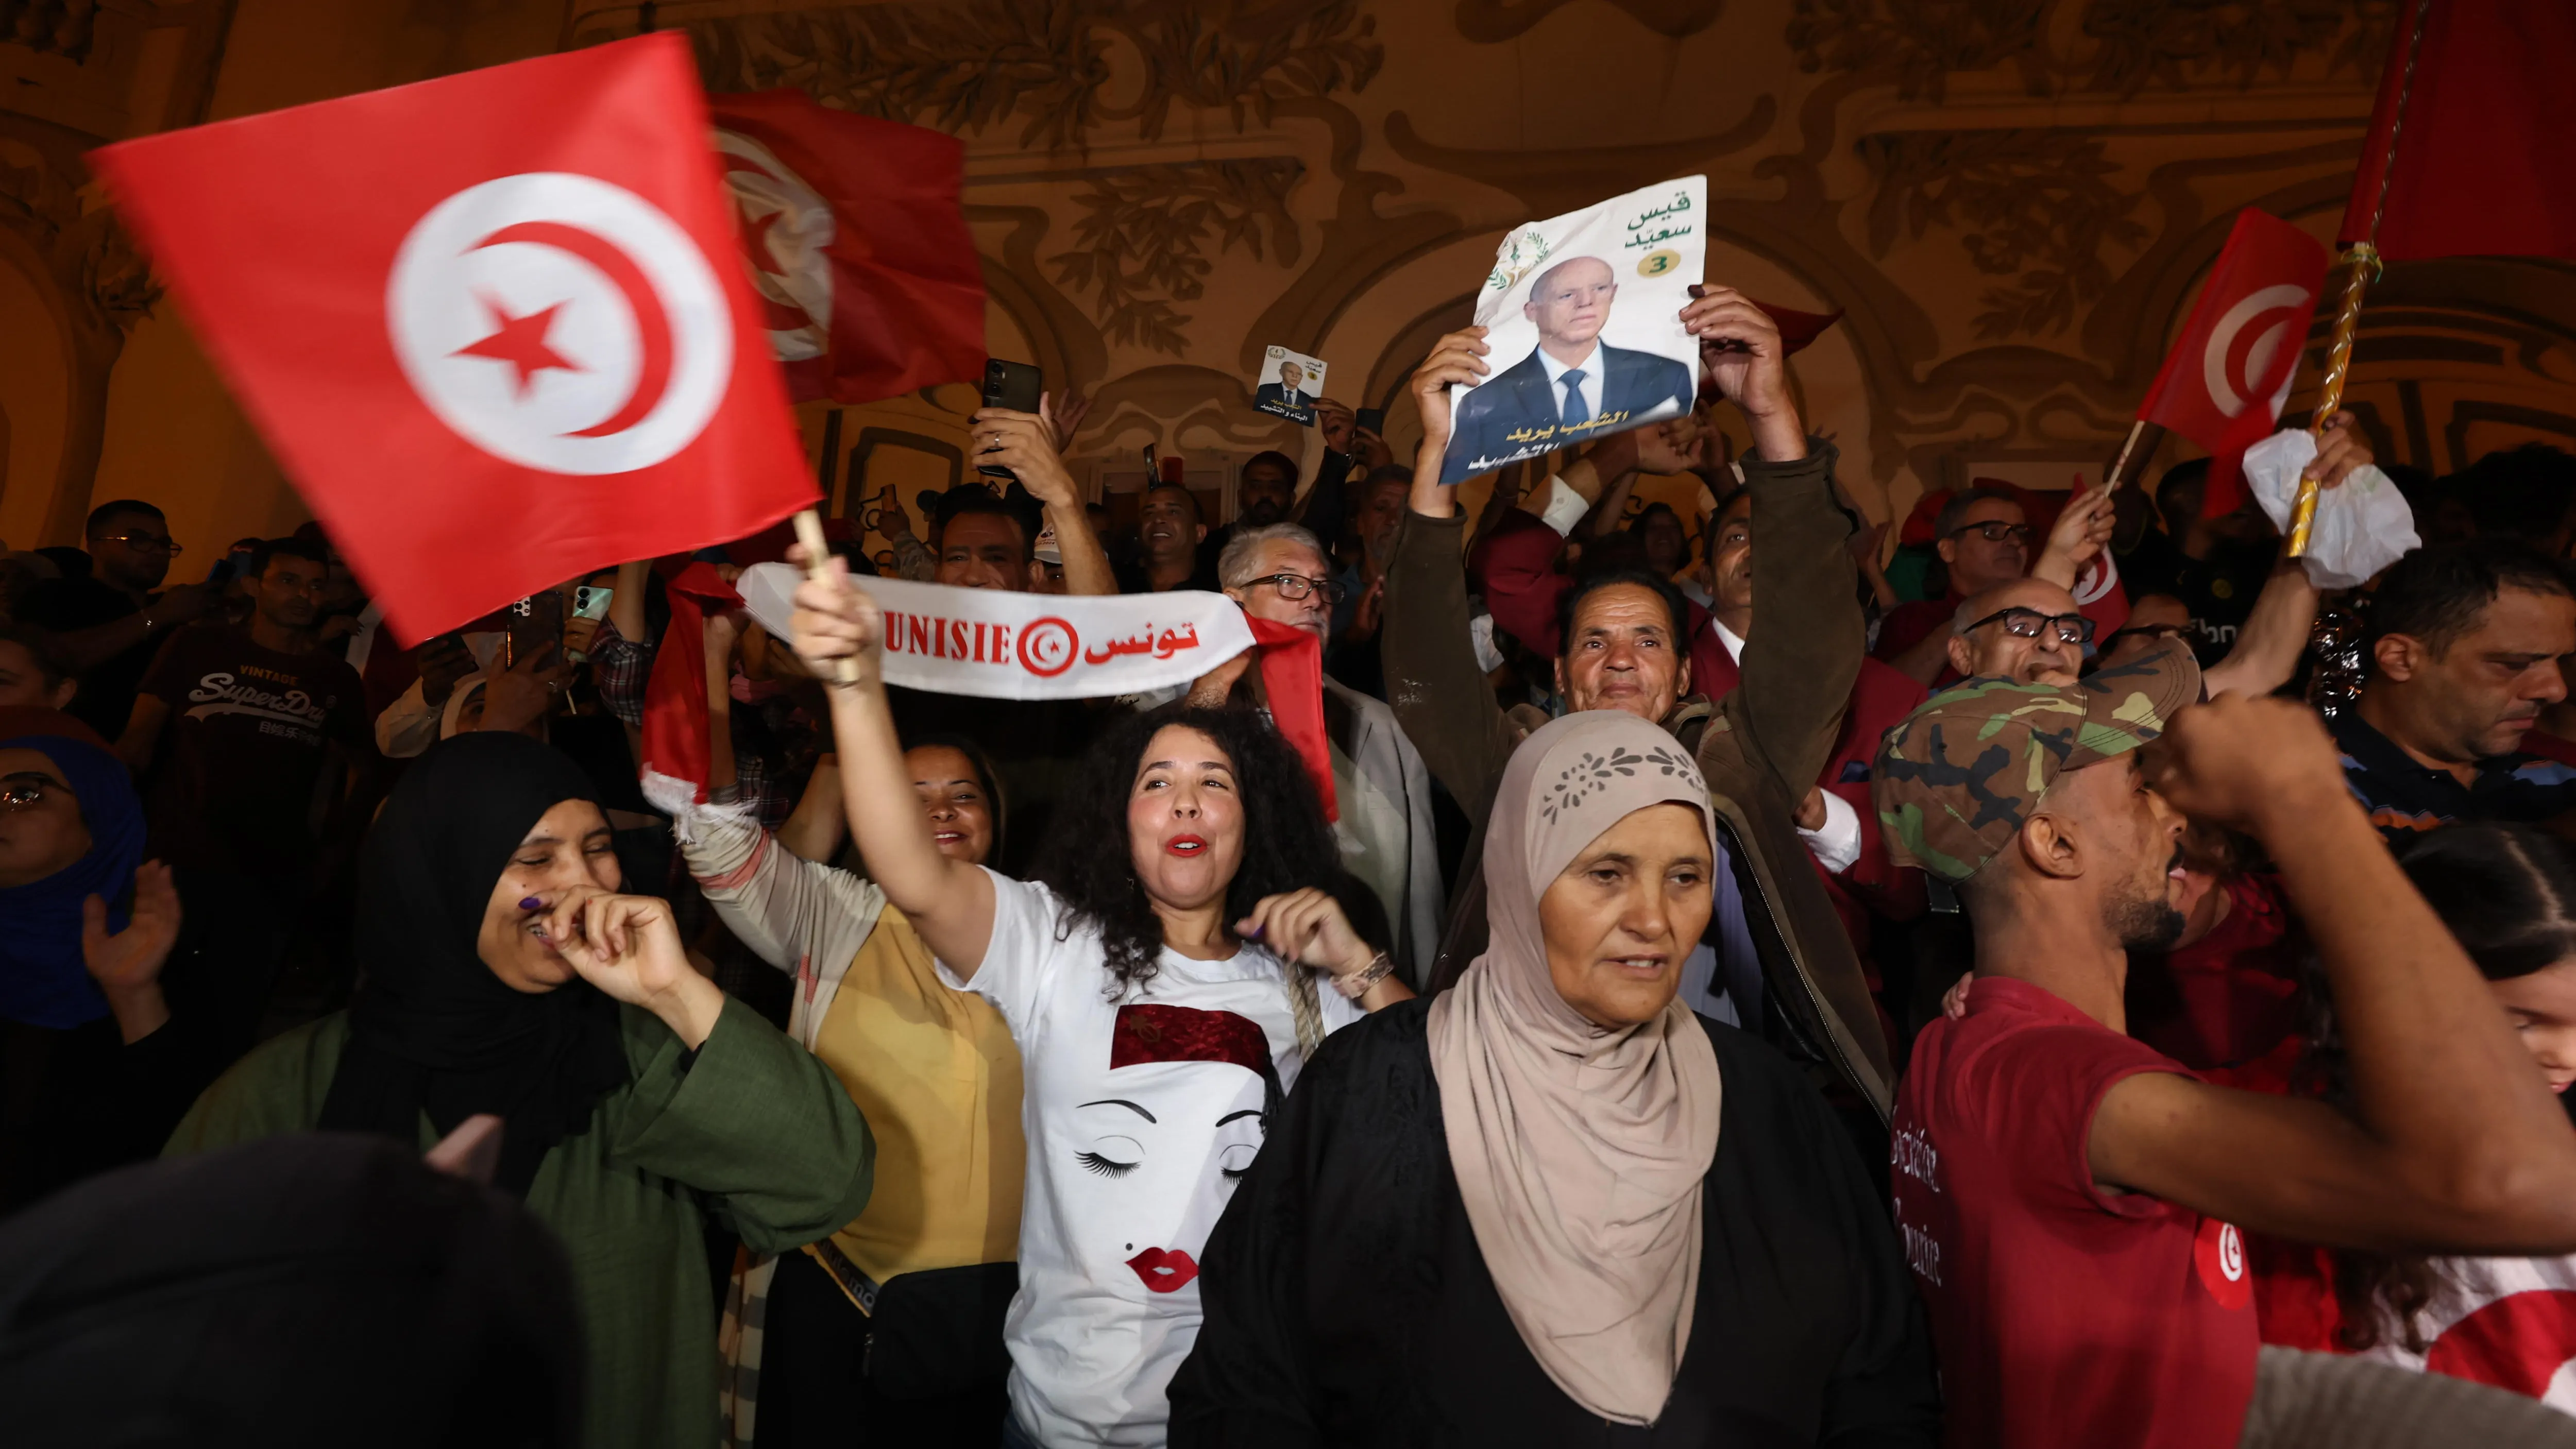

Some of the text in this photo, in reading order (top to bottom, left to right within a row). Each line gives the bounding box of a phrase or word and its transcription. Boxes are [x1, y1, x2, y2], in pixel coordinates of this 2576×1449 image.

[1628, 190, 1690, 230] قيس
[1649, 256, 1667, 274] 3
[1260, 403, 1285, 414] التشييد
[1290, 412, 1308, 422] البناء
[1505, 410, 1629, 443] الشعب يريد
[884, 611, 1011, 665] UNISIE
[1084, 622, 1200, 664] تونس
[240, 664, 299, 687] VINTAGE
